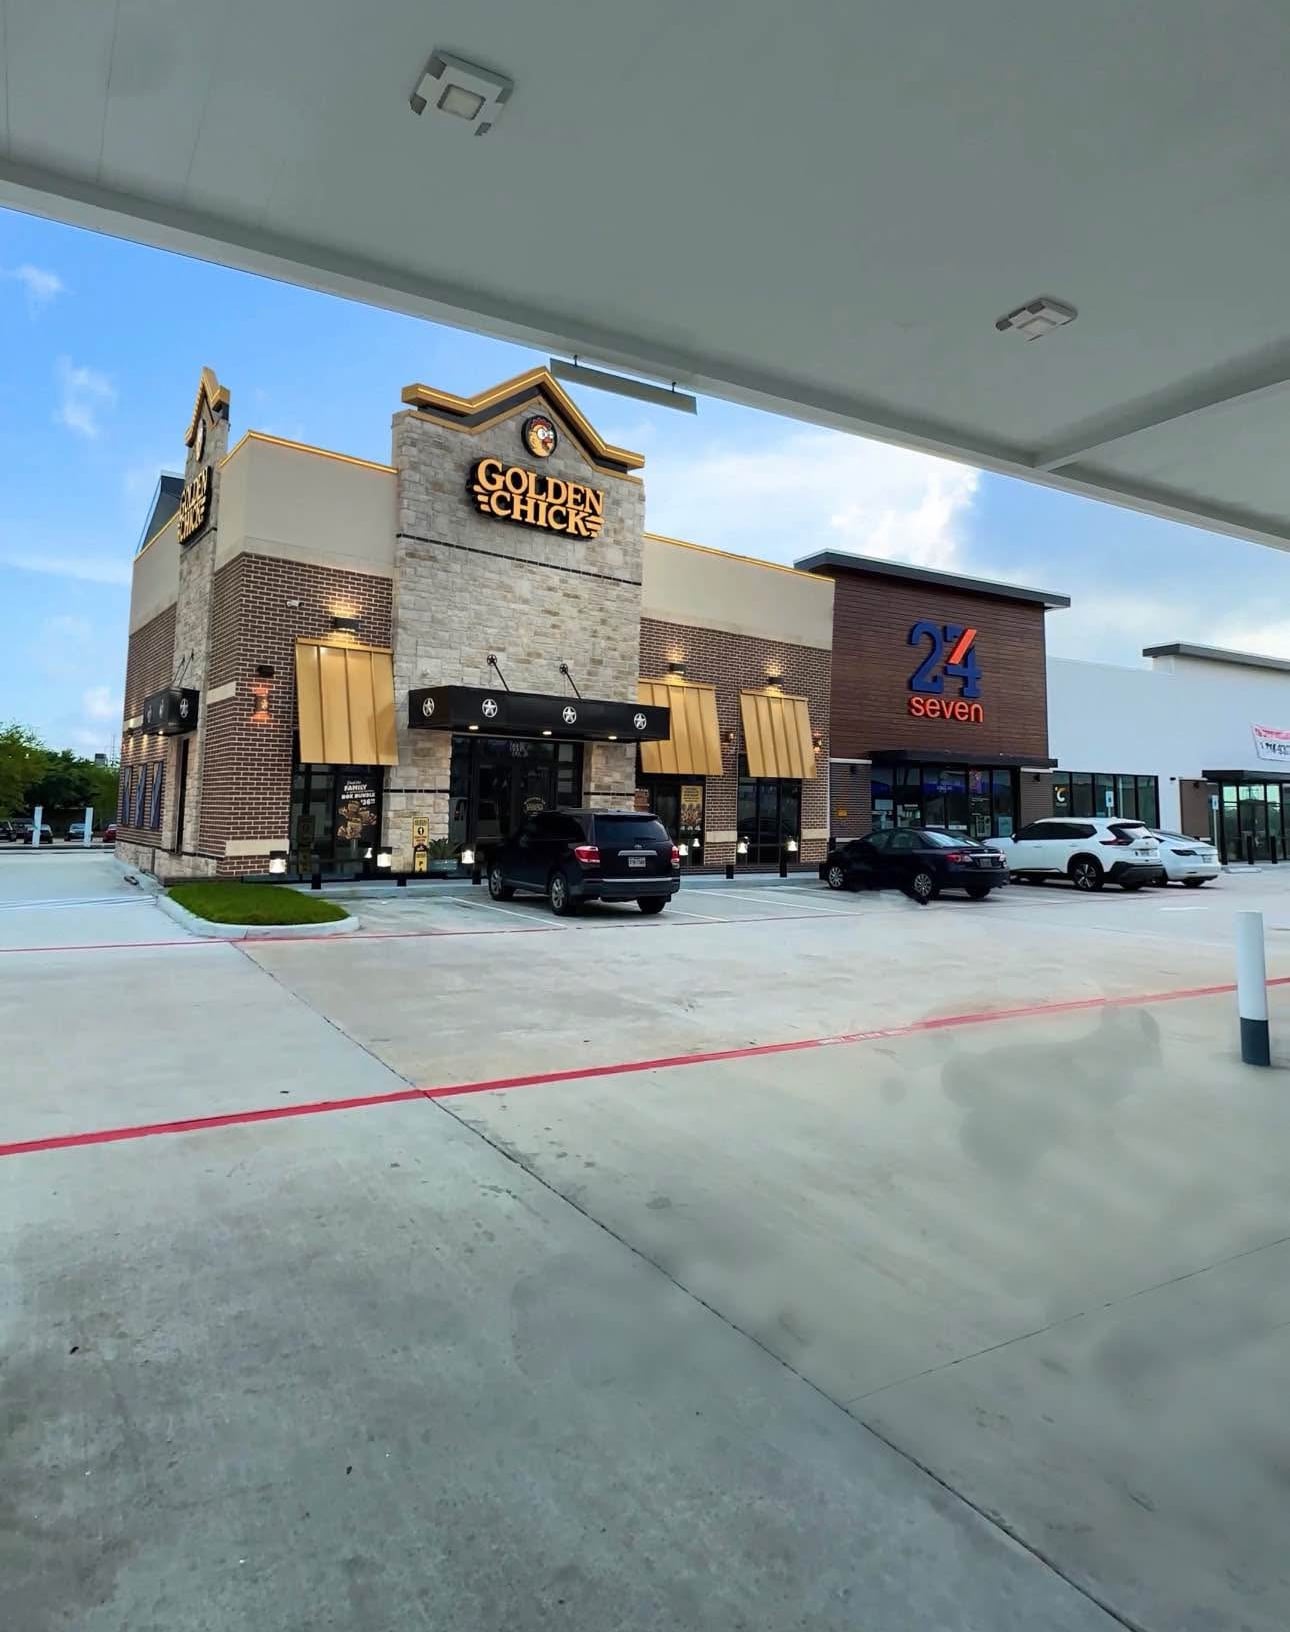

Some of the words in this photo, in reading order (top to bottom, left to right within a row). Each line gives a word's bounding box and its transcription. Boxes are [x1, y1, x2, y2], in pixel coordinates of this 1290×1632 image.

[477, 458, 605, 515] GOLDEN
[490, 490, 591, 537] CHICK
[909, 696, 984, 723] seven
